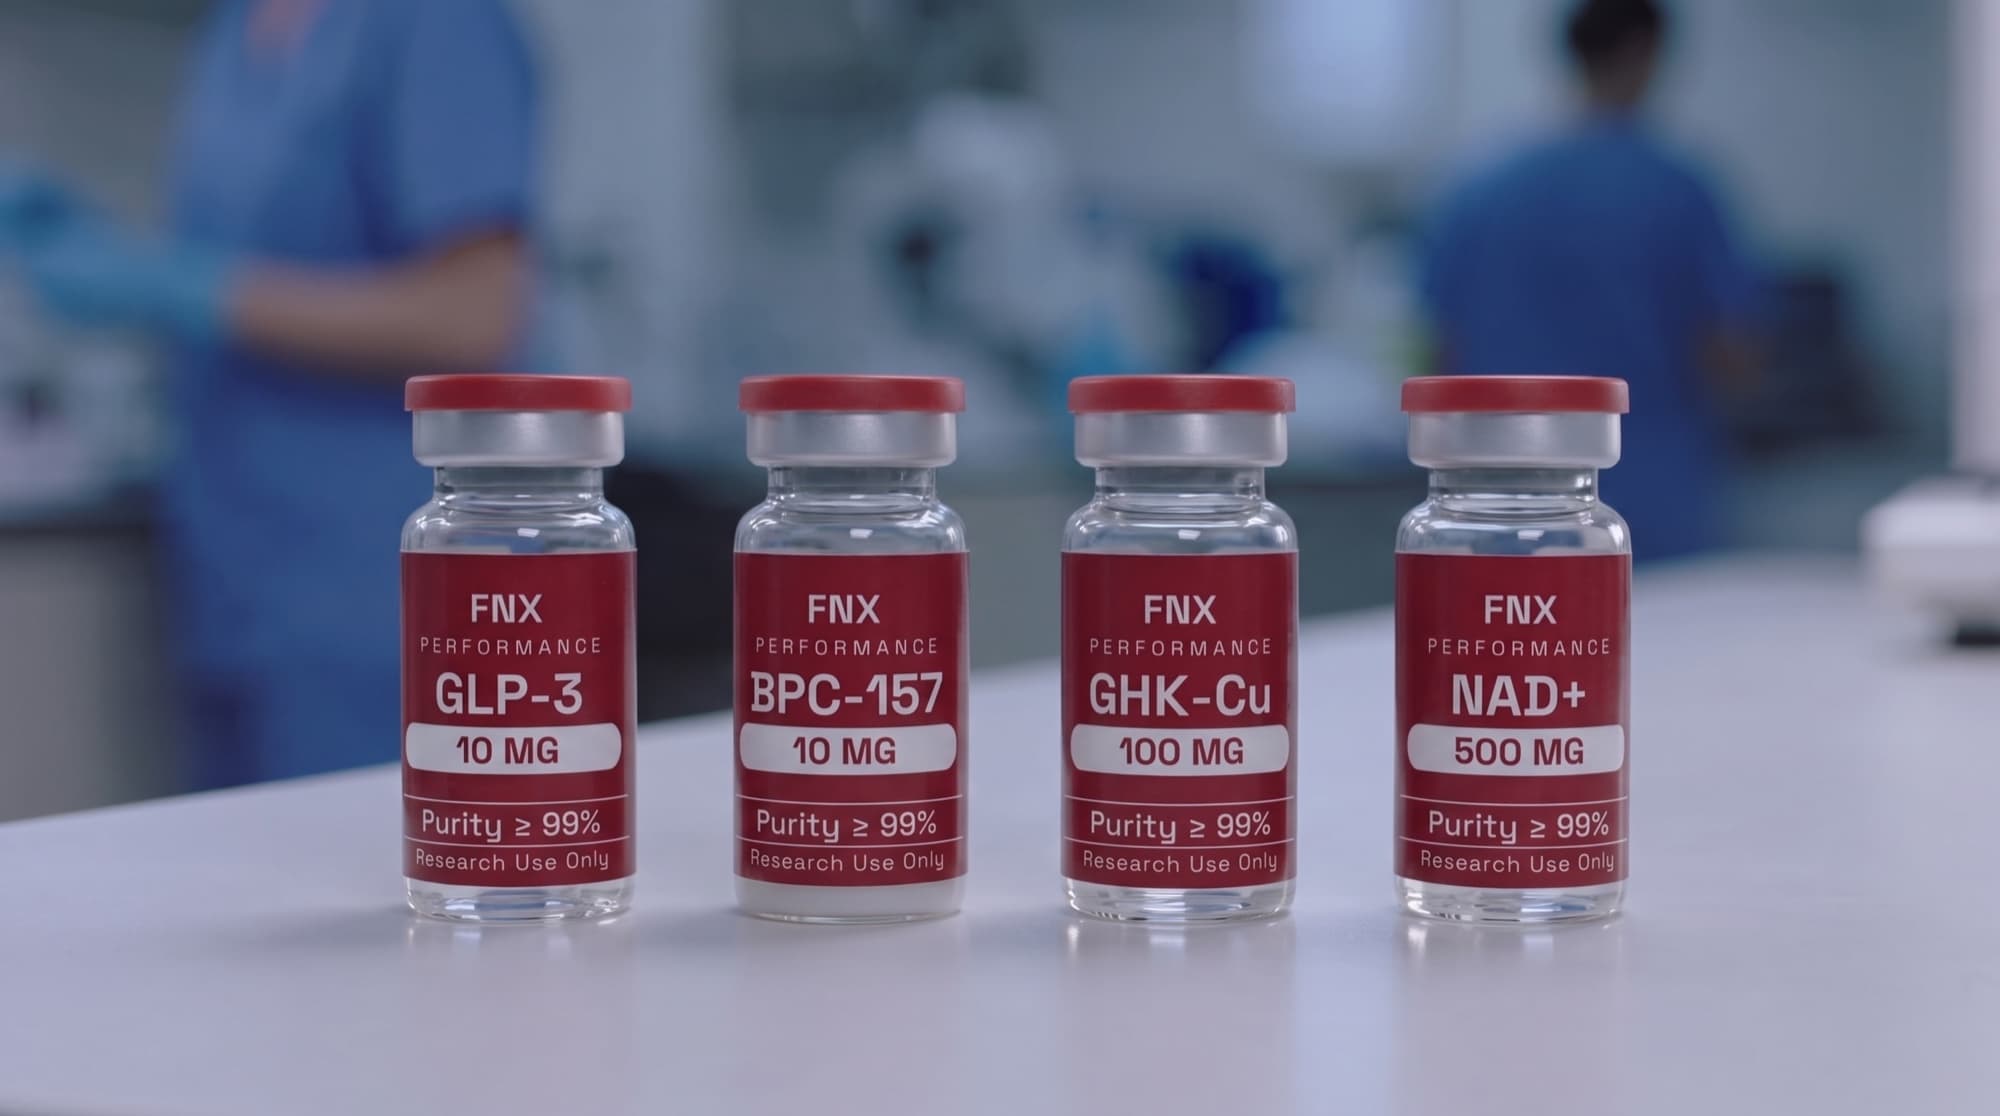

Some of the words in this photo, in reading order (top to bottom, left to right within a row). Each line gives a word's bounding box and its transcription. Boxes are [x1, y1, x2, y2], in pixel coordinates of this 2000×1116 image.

[471, 594, 543, 624] FNX
[808, 594, 880, 624] FNX
[1144, 594, 1217, 625] FNX
[1484, 595, 1557, 625] FNX
[421, 637, 601, 655] PERFORMANCE
[756, 637, 937, 656] PERFORMANCE
[1090, 638, 1271, 656] PERFORMANCE
[1428, 638, 1610, 656] PERFORMANCE
[436, 672, 583, 715] GLP-3
[750, 670, 944, 716] BPC-157
[1089, 672, 1271, 717] GHK-Cu
[1452, 673, 1586, 717] NAD+
[456, 736, 492, 764] 10
[504, 736, 559, 764] MG
[793, 737, 830, 765] 10
[842, 737, 896, 765] MG
[1120, 737, 1180, 766] 100
[1192, 737, 1244, 766] MG
[1455, 737, 1521, 766] 500
[1534, 737, 1584, 766] MG
[423, 809, 502, 843] Purity
[515, 817, 531, 837] ≥
[542, 809, 601, 837] 99%
[757, 809, 840, 843] Purity
[853, 818, 868, 837] ≥
[880, 810, 937, 837] 99%
[1091, 810, 1176, 845] Purity
[1190, 819, 1205, 838] ≥
[1217, 811, 1271, 837] 99%
[1429, 810, 1517, 845] Purity
[1530, 819, 1545, 838] ≥
[1557, 811, 1609, 838] 99%
[416, 848, 505, 871] Research
[515, 853, 557, 871] Use
[566, 850, 609, 870] Only
[751, 849, 843, 871] Research
[853, 854, 894, 871] Use
[903, 850, 944, 871] Only
[1083, 850, 1179, 872] Research
[1190, 855, 1230, 872] Use
[1239, 852, 1277, 872] Only
[1421, 850, 1519, 872] Research
[1530, 855, 1570, 872] Use
[1578, 852, 1614, 872] Only
